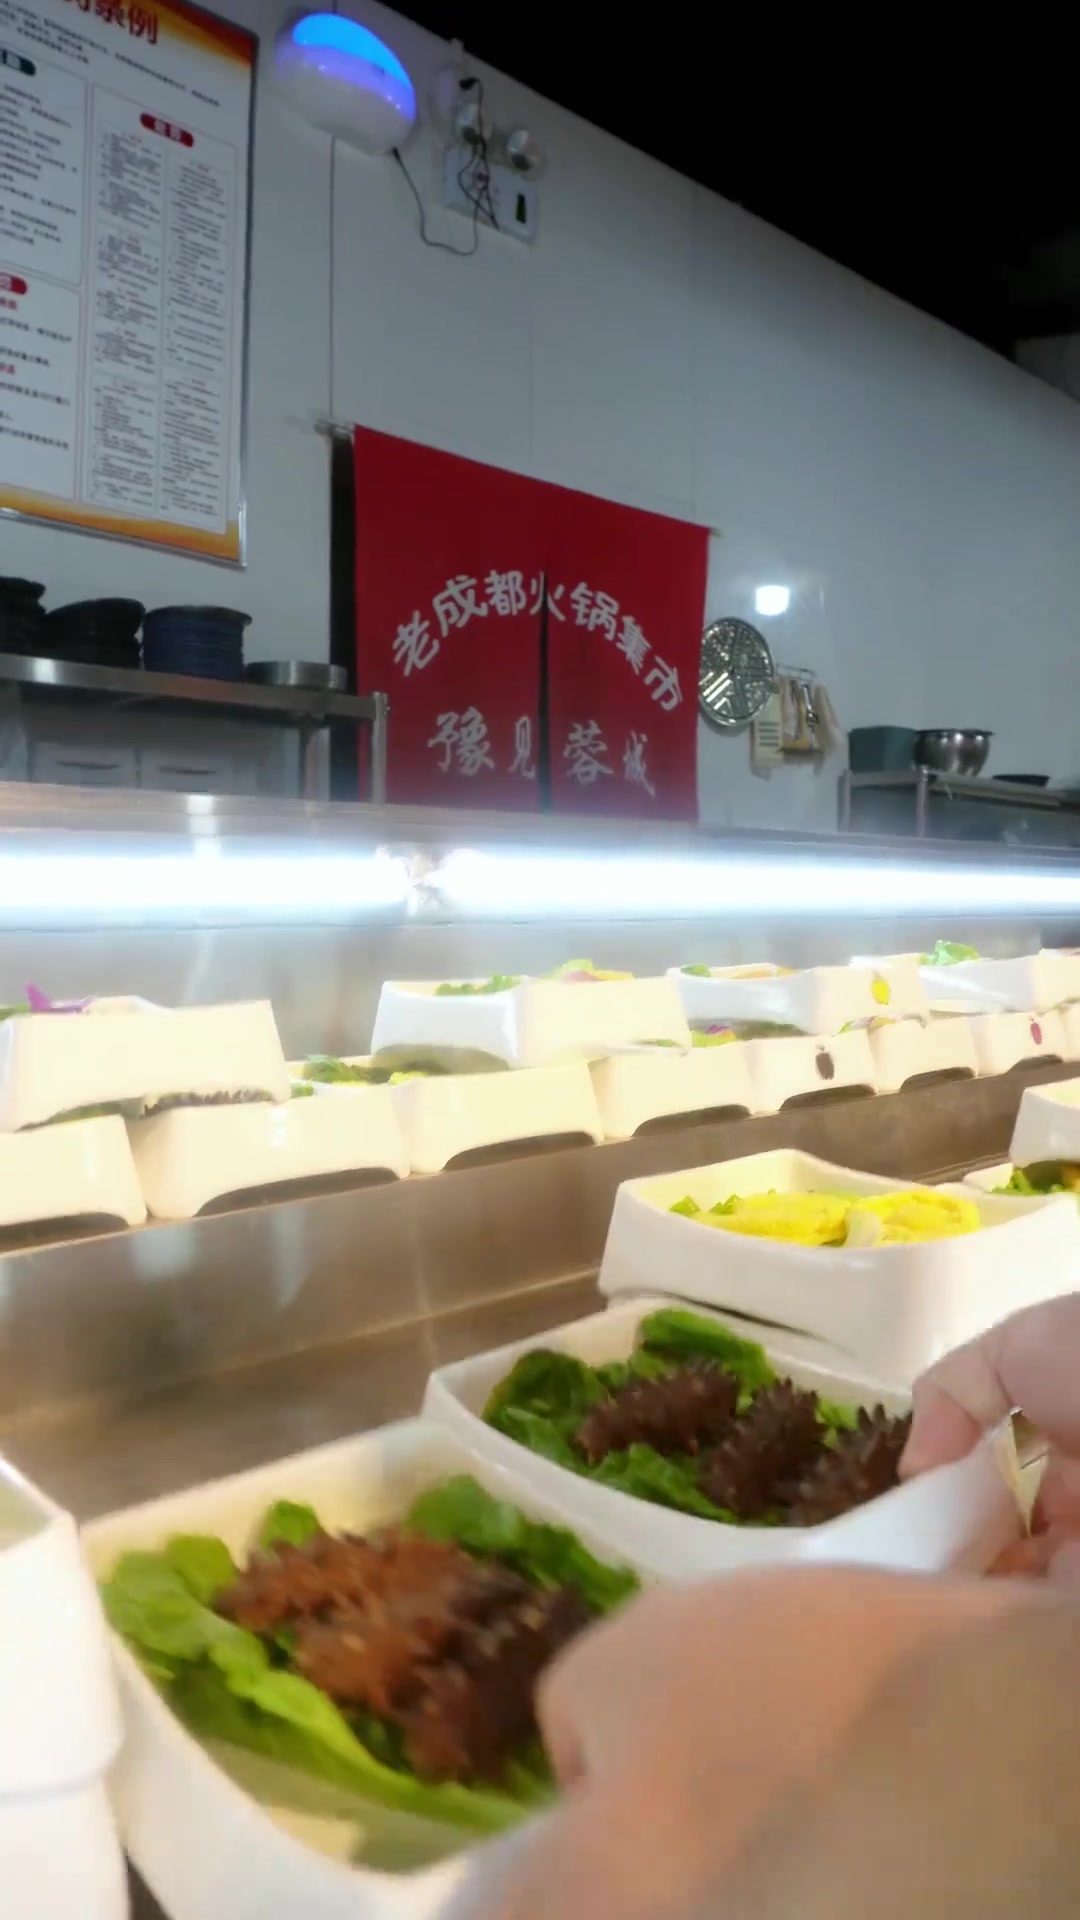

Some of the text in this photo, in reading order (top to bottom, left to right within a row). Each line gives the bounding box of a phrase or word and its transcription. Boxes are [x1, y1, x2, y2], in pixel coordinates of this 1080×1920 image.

[392, 569, 684, 712] 老成都火锅集市
